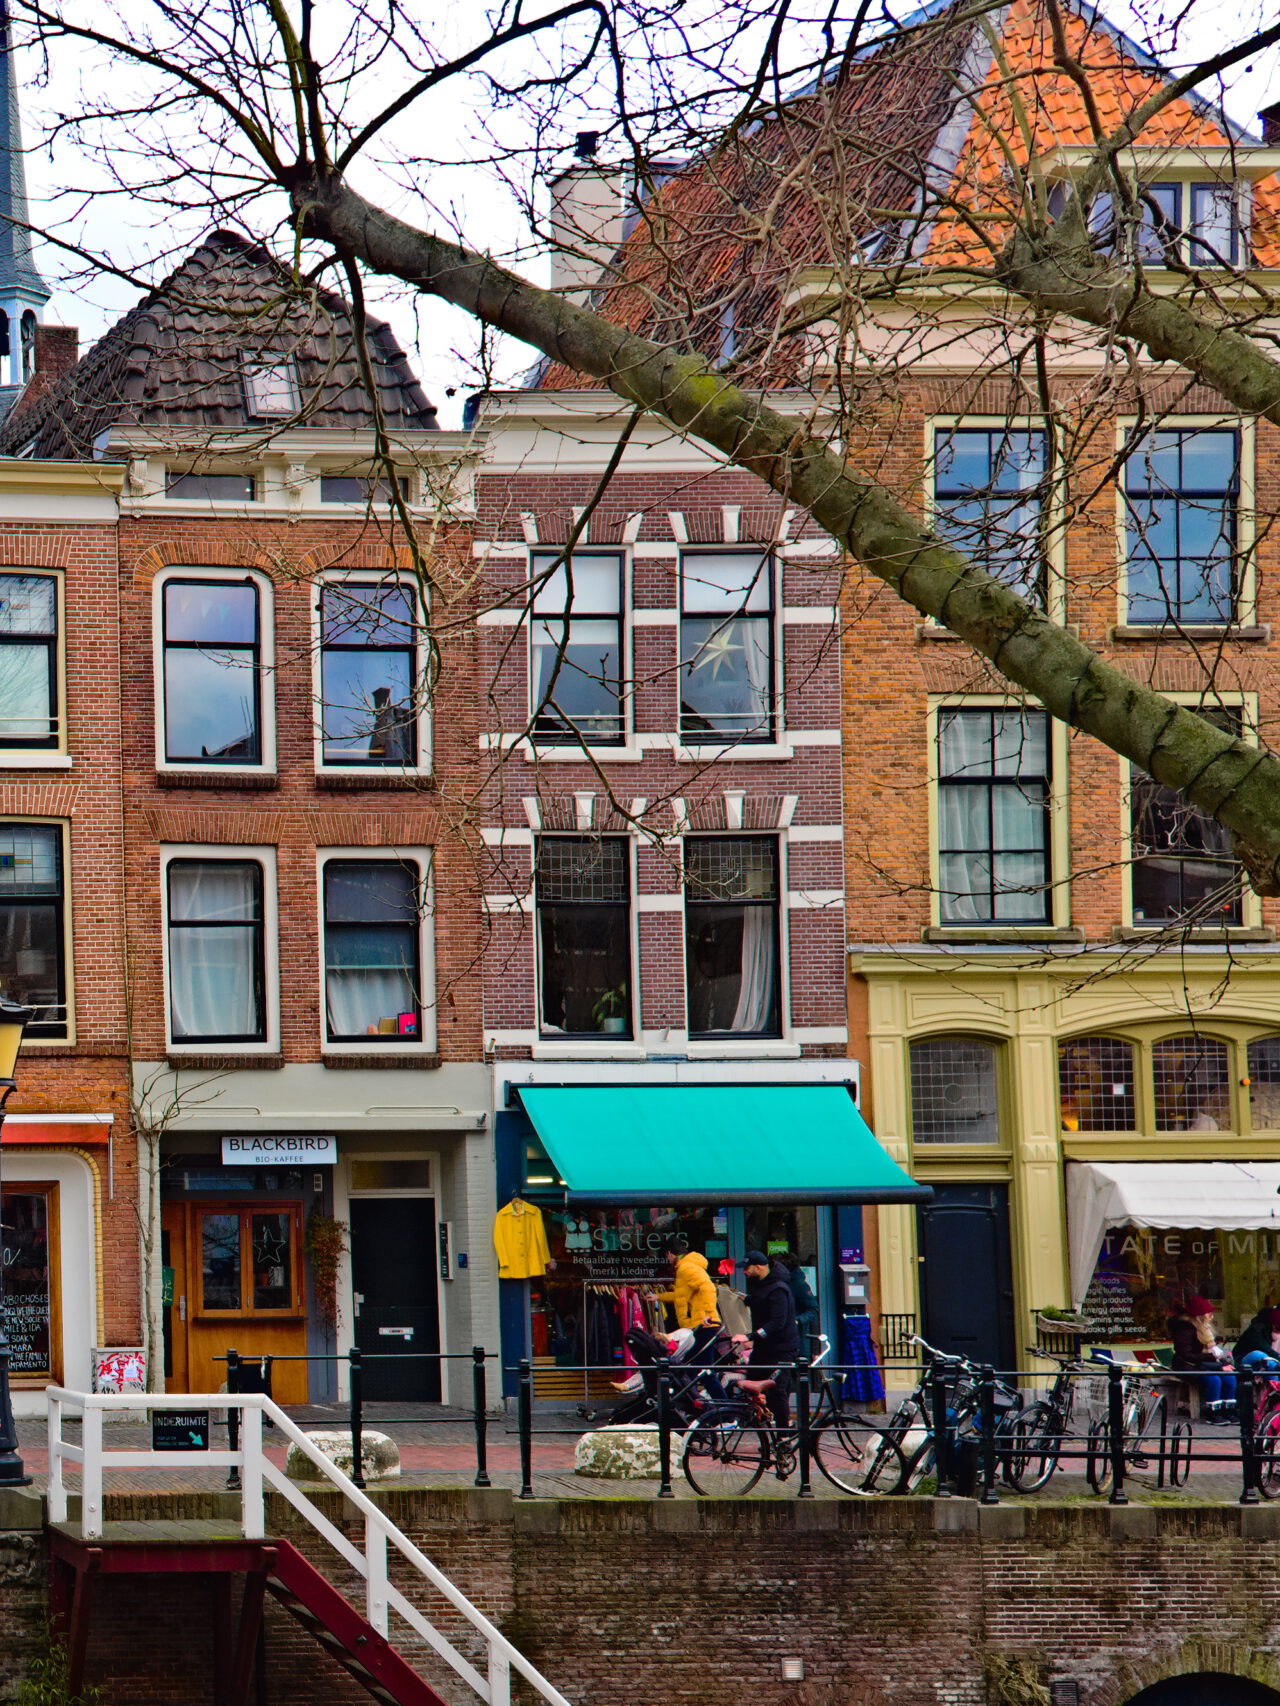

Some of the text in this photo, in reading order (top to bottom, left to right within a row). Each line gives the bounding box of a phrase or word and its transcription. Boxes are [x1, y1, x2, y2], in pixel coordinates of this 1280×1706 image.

[229, 1137, 329, 1151] BLACKBIRD
[255, 1155, 304, 1163] BIO-KAFFEE
[593, 1227, 689, 1252] Sisters
[1104, 1235, 1280, 1255] TATE OF MI
[573, 1256, 674, 1265] Betaalbare tweedehan
[589, 1266, 655, 1277] (merk) kleding
